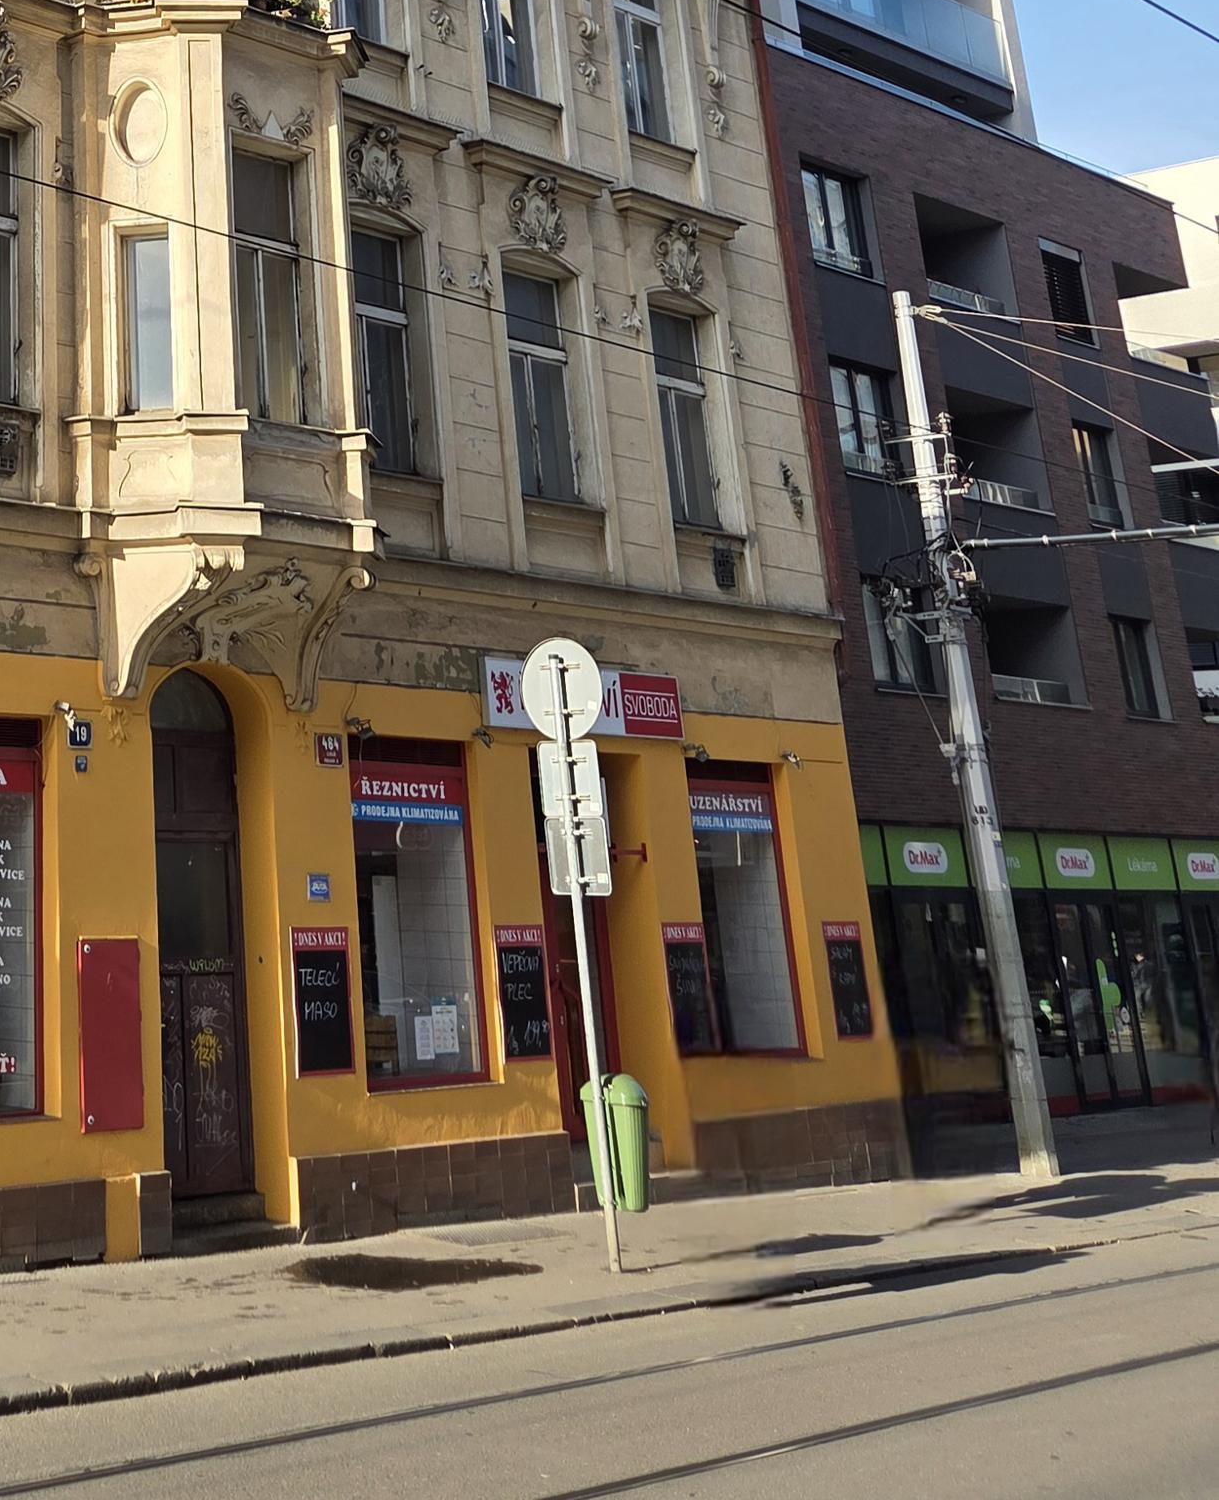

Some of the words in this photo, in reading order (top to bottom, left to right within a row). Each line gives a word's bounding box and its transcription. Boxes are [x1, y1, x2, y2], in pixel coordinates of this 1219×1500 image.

[624, 693, 678, 718] SVOBODA
[75, 726, 87, 742] 19
[361, 776, 446, 799] ŘEZNICTVÍ
[689, 794, 763, 813] UZENÁŘSTVÍ
[361, 805, 401, 818] PRODEJNA
[402, 807, 459, 821] KLIMATIZOVÁNA
[298, 932, 317, 946] DNES
[318, 932, 324, 946] V
[324, 932, 342, 946] AKCI
[500, 929, 517, 941] DNES
[522, 929, 538, 941] AKCI
[299, 962, 340, 987] TELECÍ
[506, 983, 533, 1000] PLEC
[304, 1001, 338, 1021] MASO
